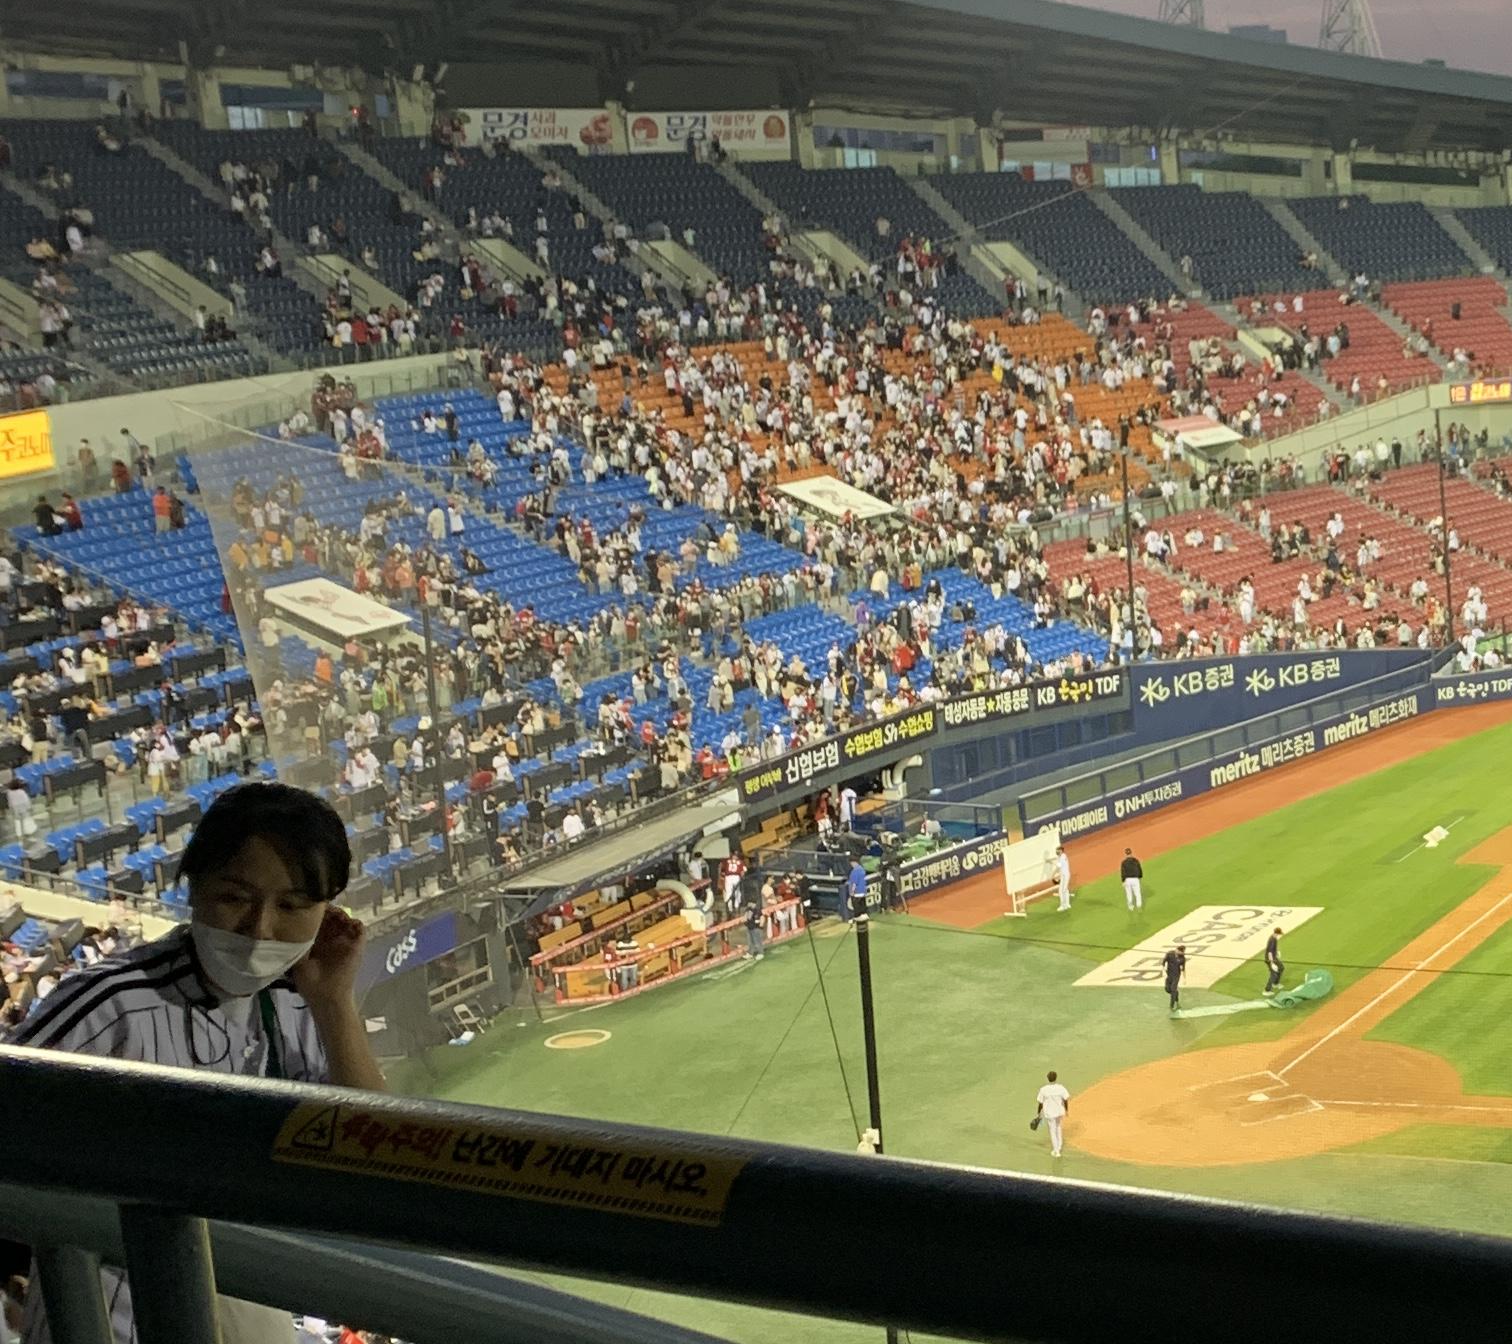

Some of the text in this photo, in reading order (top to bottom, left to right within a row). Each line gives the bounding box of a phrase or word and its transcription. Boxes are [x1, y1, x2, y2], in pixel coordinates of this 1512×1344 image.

[1174, 664, 1234, 695] KB증권
[1279, 657, 1340, 687] KB증권
[1037, 687, 1056, 706] KB
[1096, 674, 1120, 695] TDF
[1437, 687, 1455, 701] KB
[1324, 712, 1368, 746] meritz
[786, 741, 839, 784] 신협보험
[1210, 750, 1260, 788] meritz
[1125, 780, 1182, 814] NH투자증권
[534, 1142, 621, 1184] 기대지
